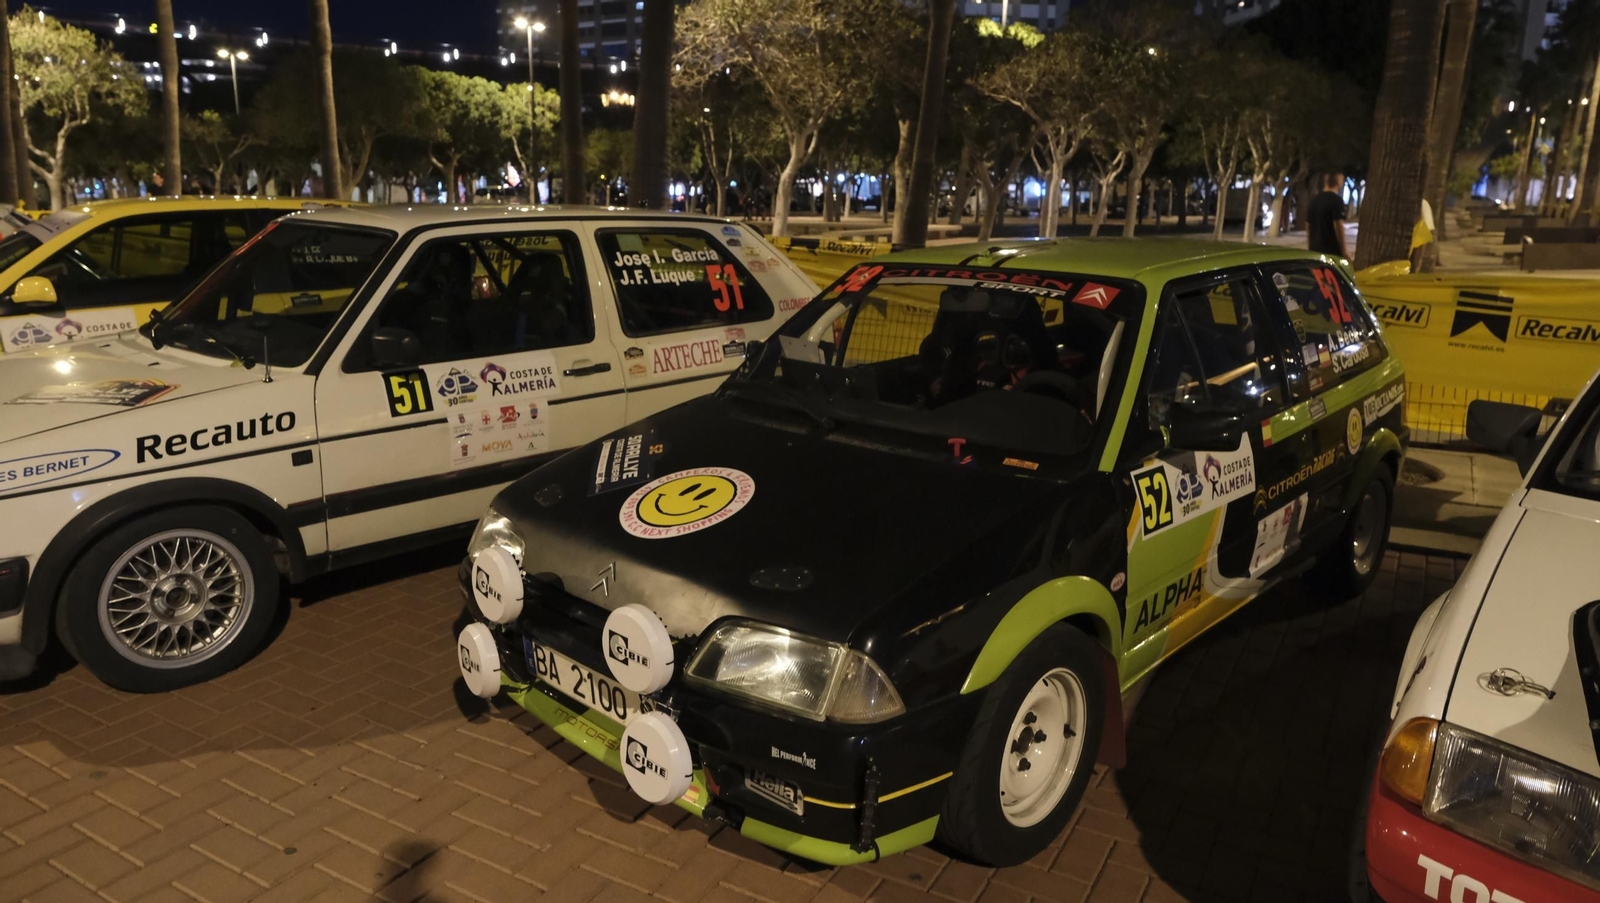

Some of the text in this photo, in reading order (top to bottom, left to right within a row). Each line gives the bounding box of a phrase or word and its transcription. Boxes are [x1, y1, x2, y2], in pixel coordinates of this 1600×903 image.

[620, 268, 696, 287] J.F. Luque
[705, 263, 745, 312] 51
[980, 280, 1067, 298] SPORT
[1311, 268, 1353, 325] 52
[86, 321, 132, 334] COSTA DE
[652, 339, 723, 374] ARTECHE
[503, 376, 557, 396] ALMERÍA
[509, 366, 553, 380] COSTA DE
[389, 373, 427, 415] 51
[135, 411, 297, 464] Recauto
[22, 455, 90, 478] BERNET
[622, 444, 641, 480] RALLYE
[1222, 456, 1251, 476] COSTA DE
[1218, 469, 1254, 497] ALMERÍA
[1138, 471, 1172, 530] 52
[676, 508, 733, 535] SHOPPING
[1132, 566, 1204, 634] ALPHA
[534, 643, 561, 686] BA
[571, 663, 628, 720] 2100
